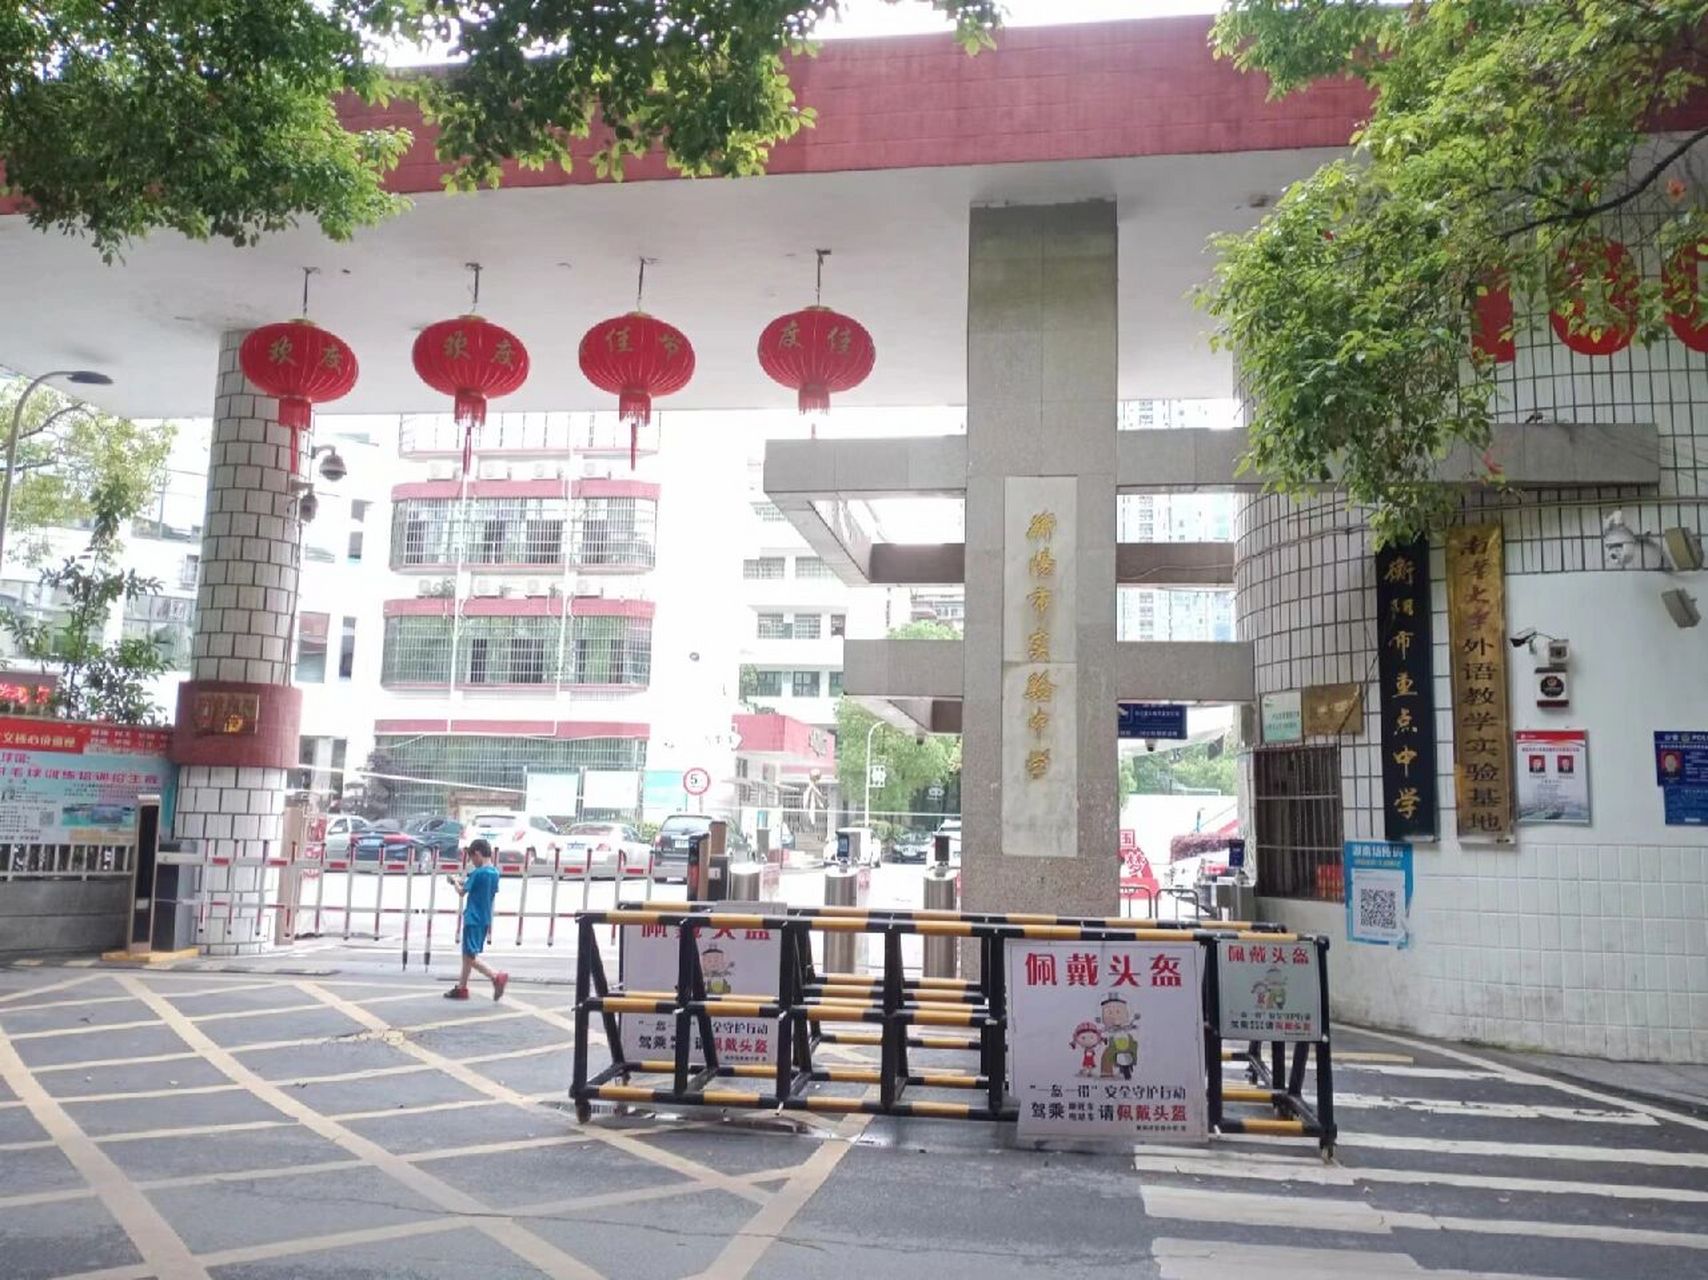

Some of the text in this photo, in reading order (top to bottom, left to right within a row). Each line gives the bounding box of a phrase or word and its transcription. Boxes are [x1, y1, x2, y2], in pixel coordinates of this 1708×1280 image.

[1025, 952, 1183, 988] 佩戴头盔
[1031, 1102, 1065, 1120] 驾乘
